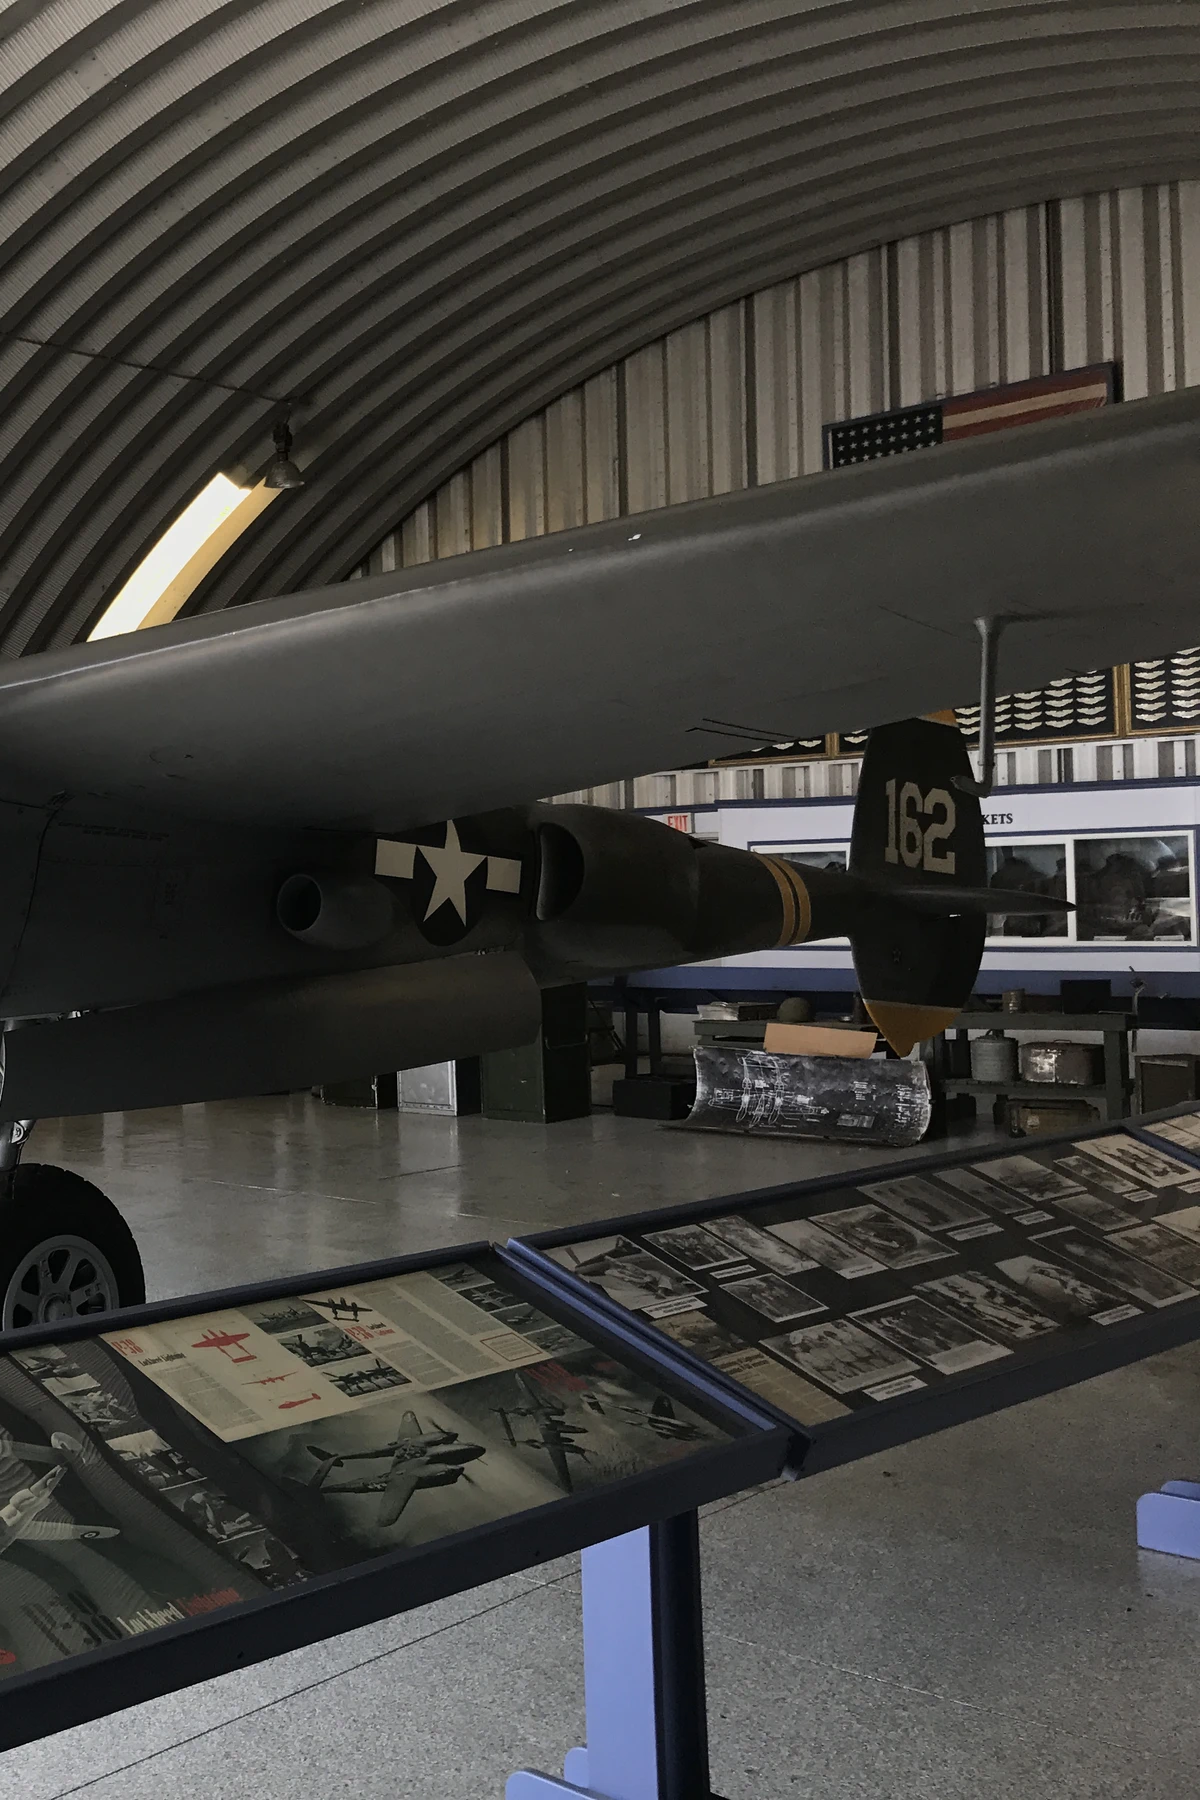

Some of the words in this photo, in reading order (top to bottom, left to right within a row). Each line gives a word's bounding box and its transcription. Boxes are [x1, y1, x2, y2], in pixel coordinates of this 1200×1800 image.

[667, 815, 688, 832] EXIT
[885, 778, 956, 875] 162
[982, 813, 1013, 825] KETS
[117, 1601, 185, 1635] Lockheed
